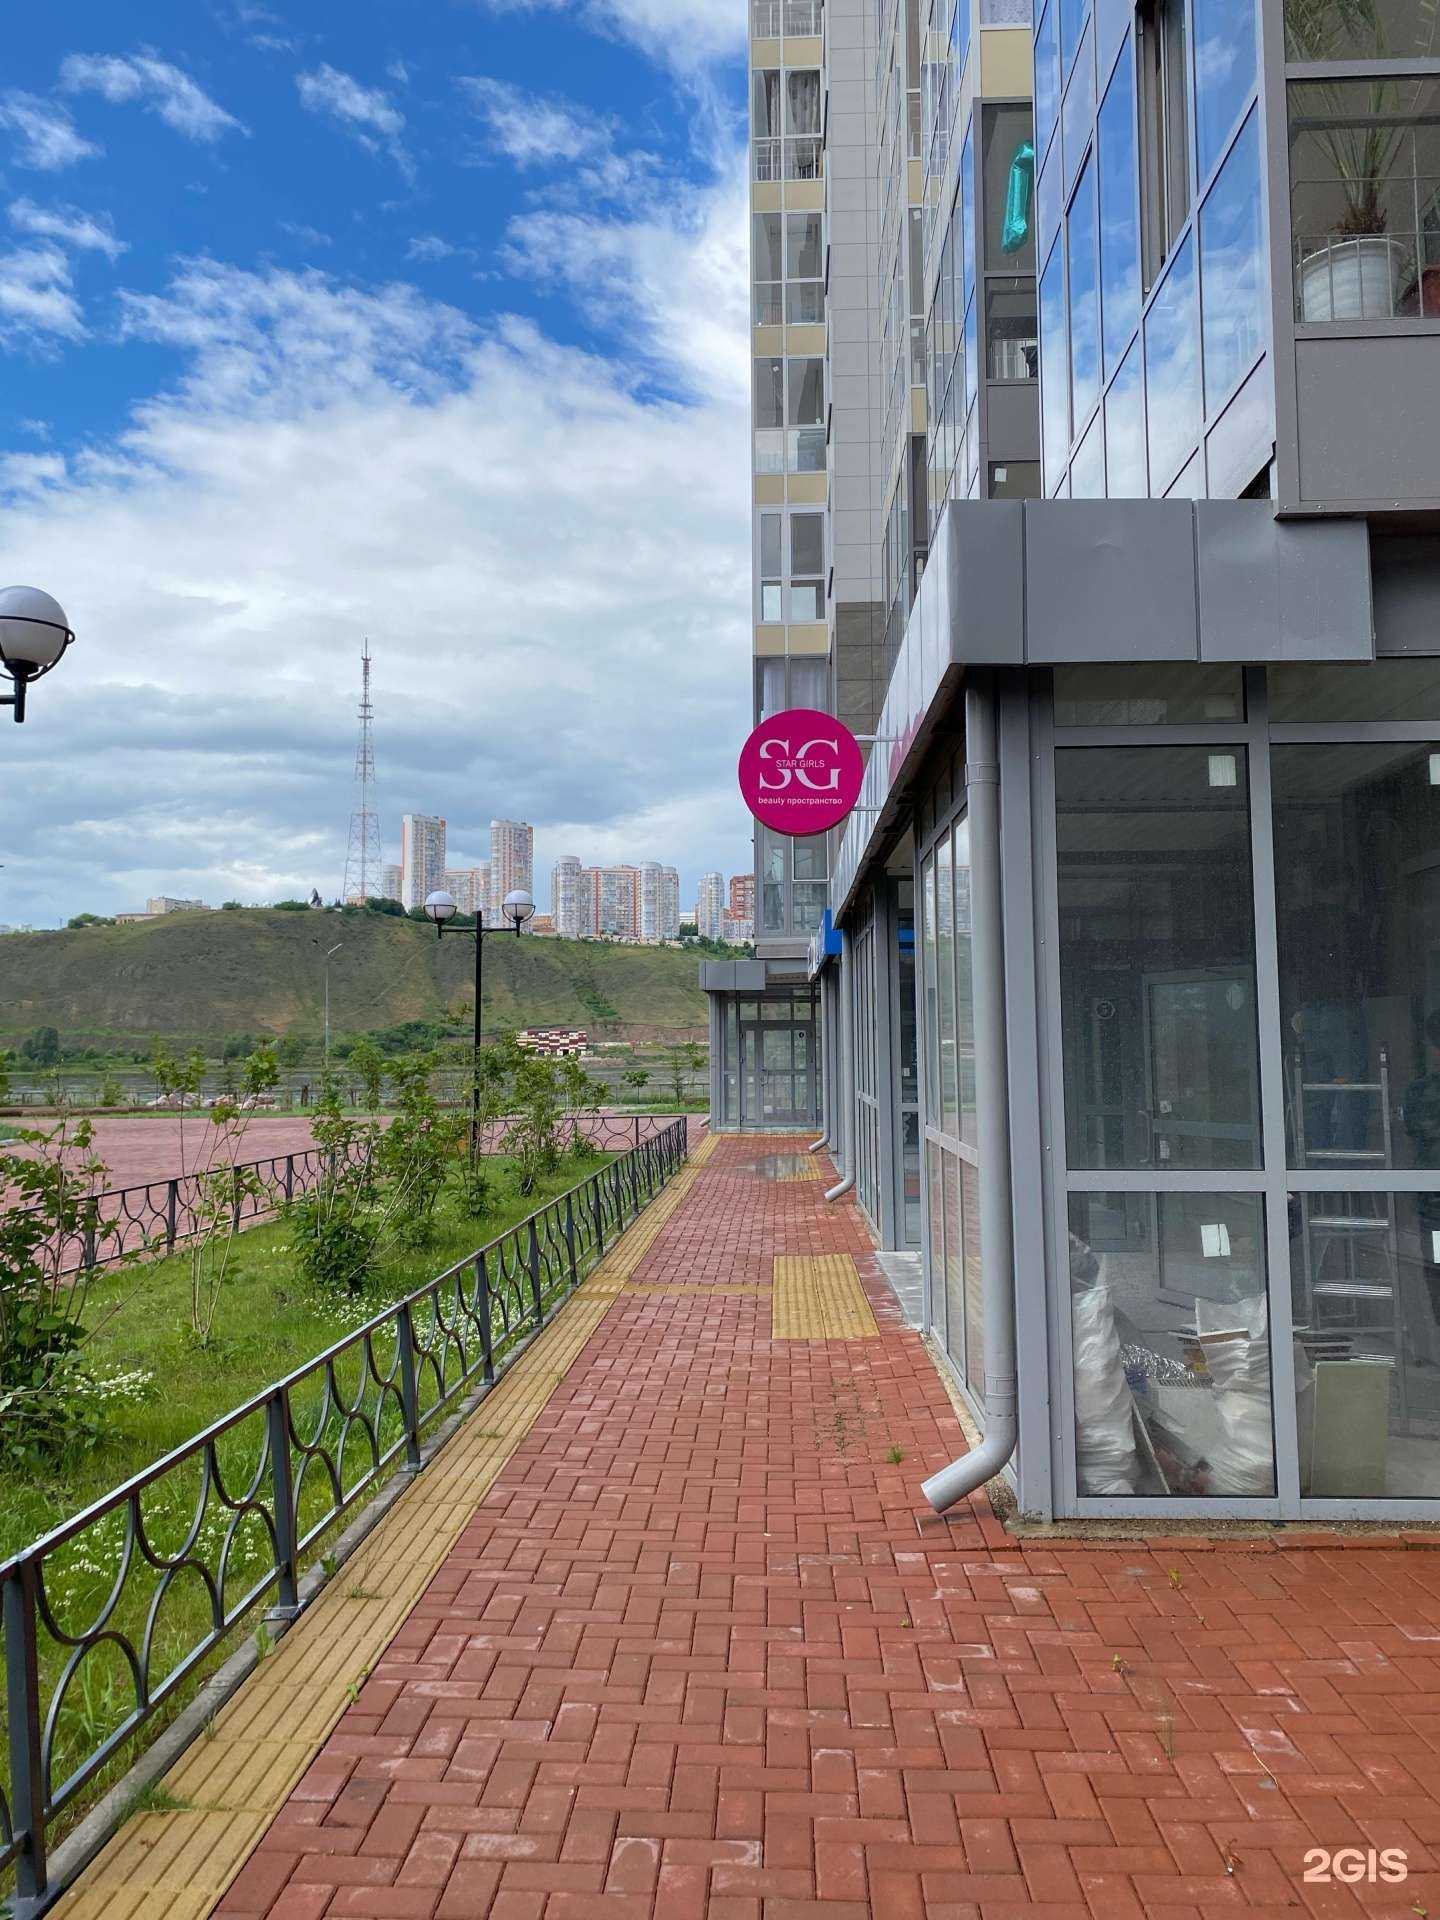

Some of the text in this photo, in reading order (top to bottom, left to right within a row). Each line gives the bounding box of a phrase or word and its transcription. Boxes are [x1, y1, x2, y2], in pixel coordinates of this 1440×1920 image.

[759, 739, 841, 790] SG
[776, 759, 825, 768] STAR GIRLS
[758, 797, 784, 805] beauty
